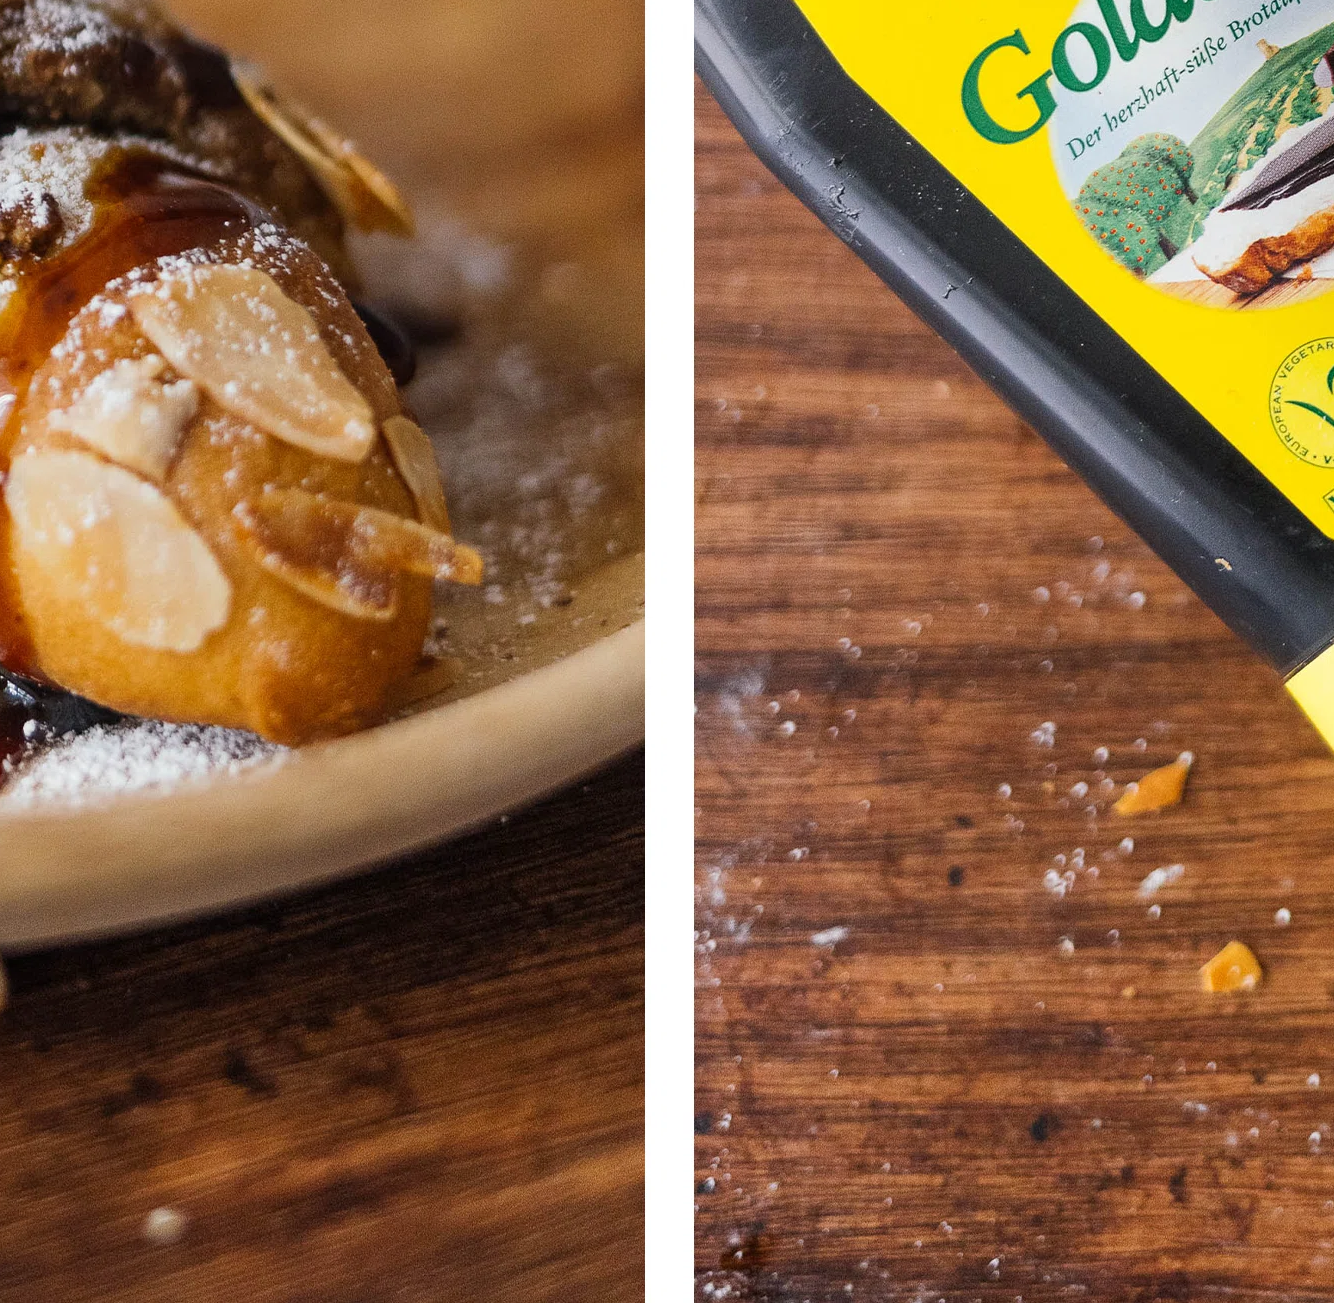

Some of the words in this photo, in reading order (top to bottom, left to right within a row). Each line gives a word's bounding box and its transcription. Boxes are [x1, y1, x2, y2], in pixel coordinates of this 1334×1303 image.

[1065, 122, 1102, 161] Der
[1103, 38, 1228, 133] herzhaft-süße
[1272, 384, 1309, 457] EUROPEAN
